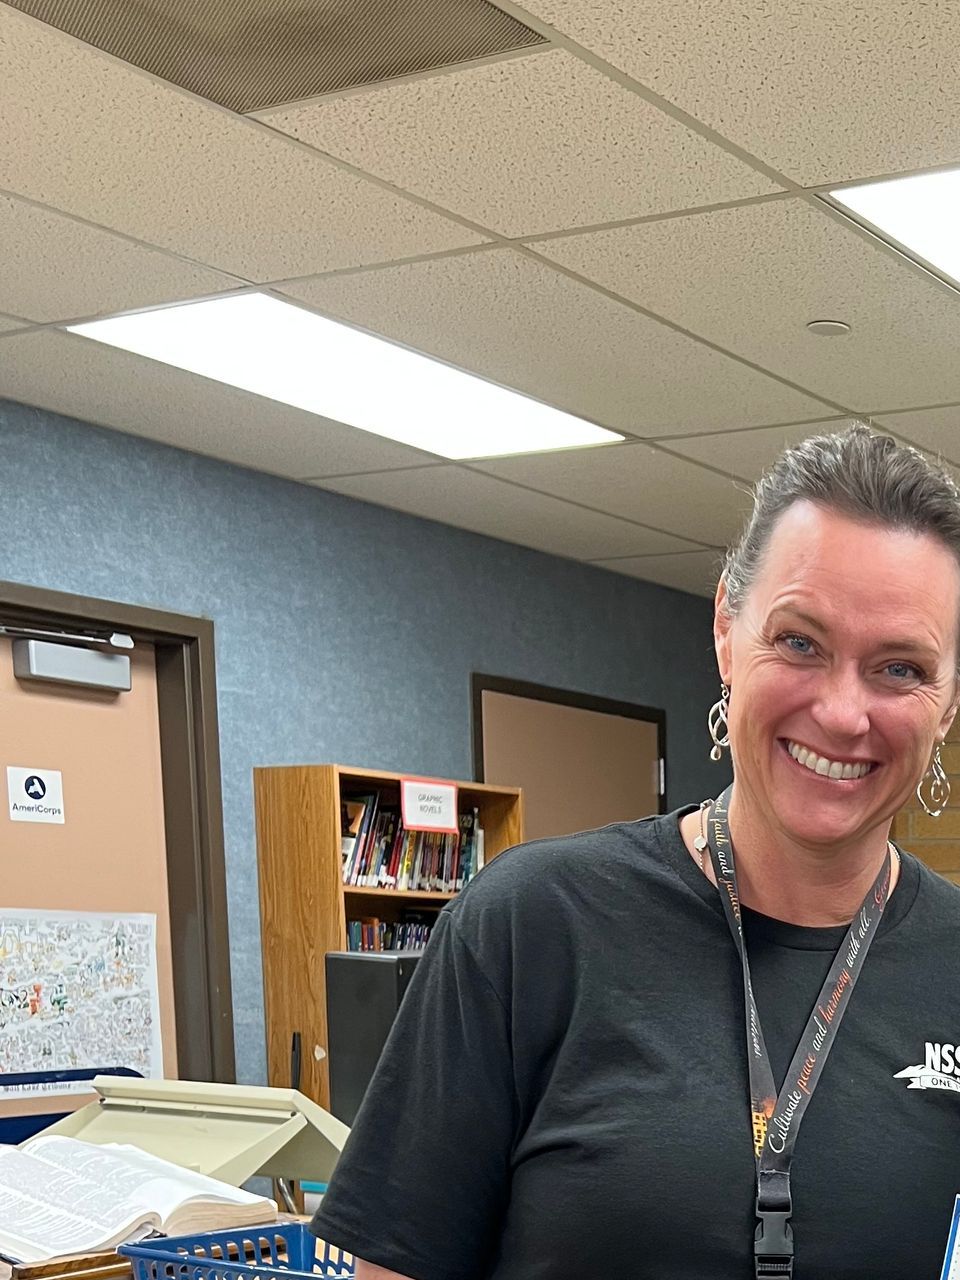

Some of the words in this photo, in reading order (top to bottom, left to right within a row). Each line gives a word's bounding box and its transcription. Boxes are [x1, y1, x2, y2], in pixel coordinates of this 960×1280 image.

[12, 803, 61, 816] AmeriCorps
[417, 794, 443, 803] GRAPHIC
[419, 805, 442, 814] NOVELS
[709, 817, 729, 848] faith
[718, 851, 734, 878] and
[718, 876, 742, 921] justice
[845, 930, 861, 968] with
[818, 968, 854, 1025] harmony
[812, 1015, 828, 1051] and
[797, 1052, 817, 1096] peace
[931, 1077, 953, 1088] ONE
[768, 1090, 802, 1154] Cultivate
